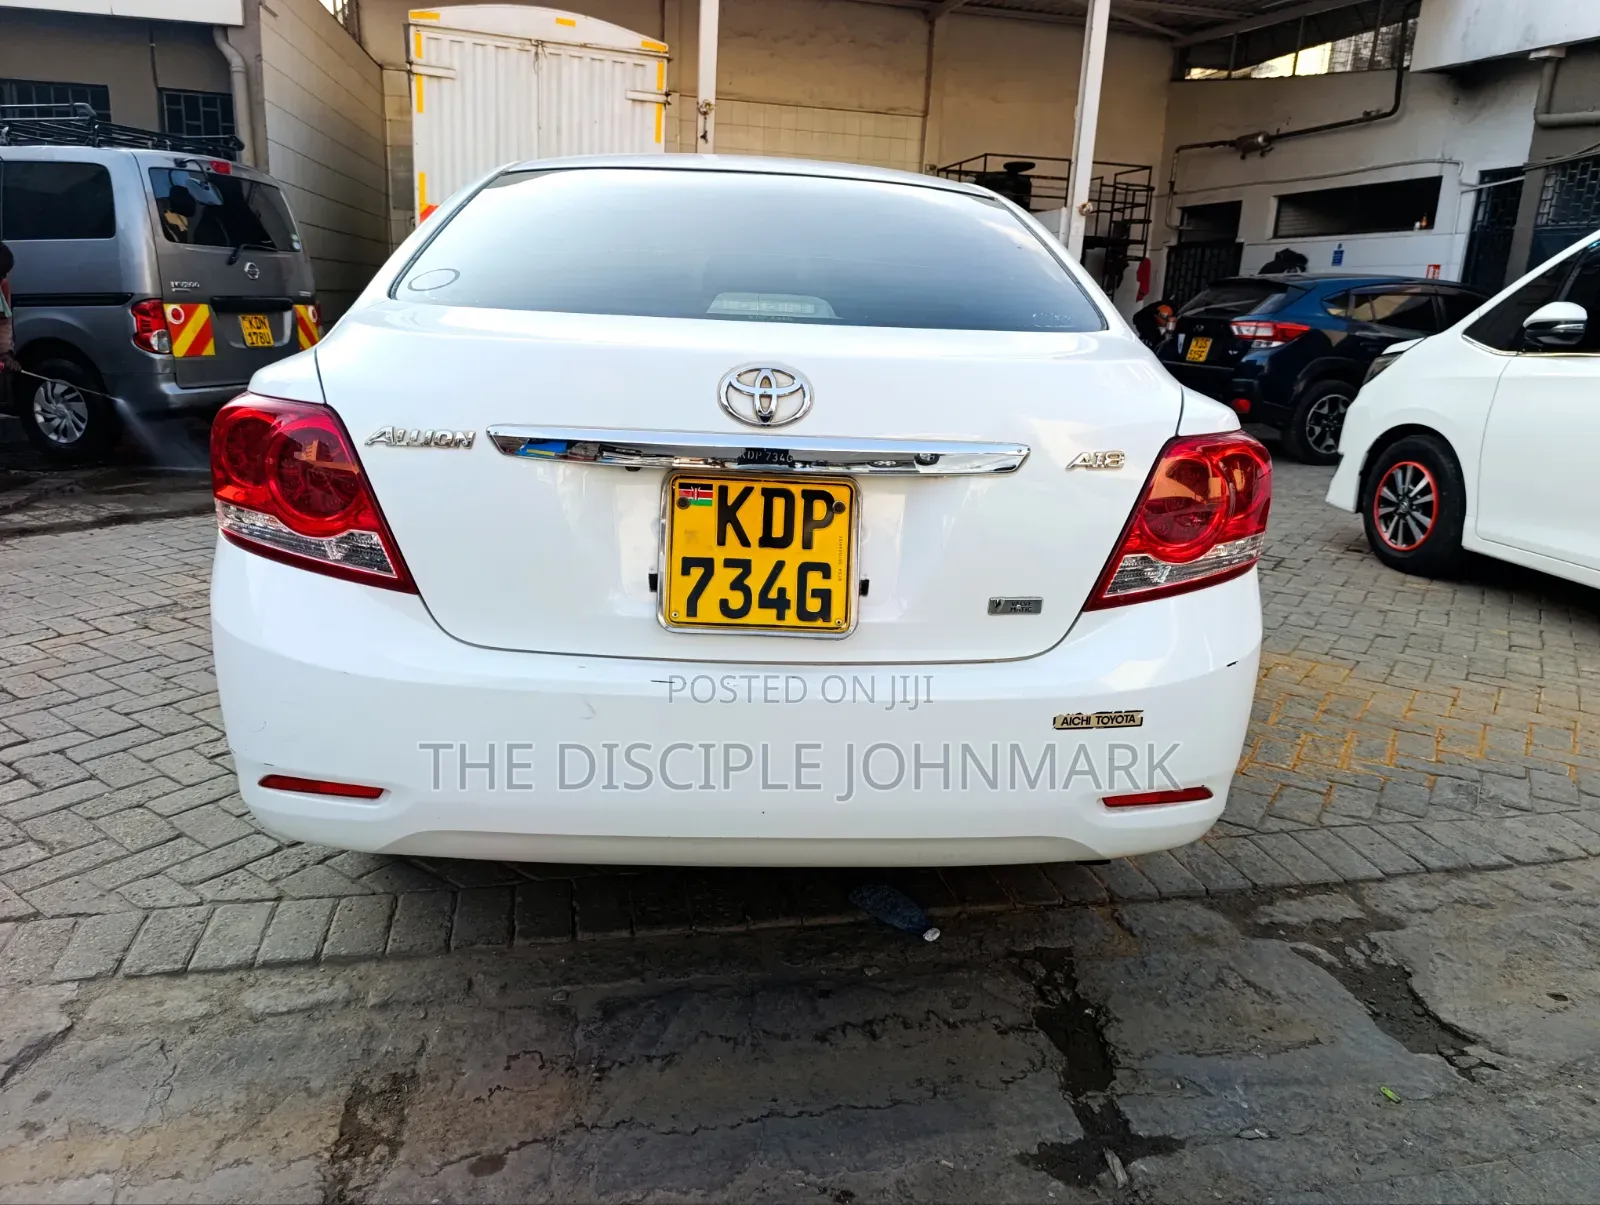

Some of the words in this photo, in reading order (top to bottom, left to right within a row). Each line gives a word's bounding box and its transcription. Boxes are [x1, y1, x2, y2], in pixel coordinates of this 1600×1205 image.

[364, 426, 476, 449] ALLION
[766, 451, 794, 463] 734G
[1065, 450, 1125, 470] A18
[716, 485, 835, 550] KDP
[681, 556, 832, 623] 734G
[1061, 716, 1092, 727] AICHI
[1095, 714, 1136, 725] TOYOTA
